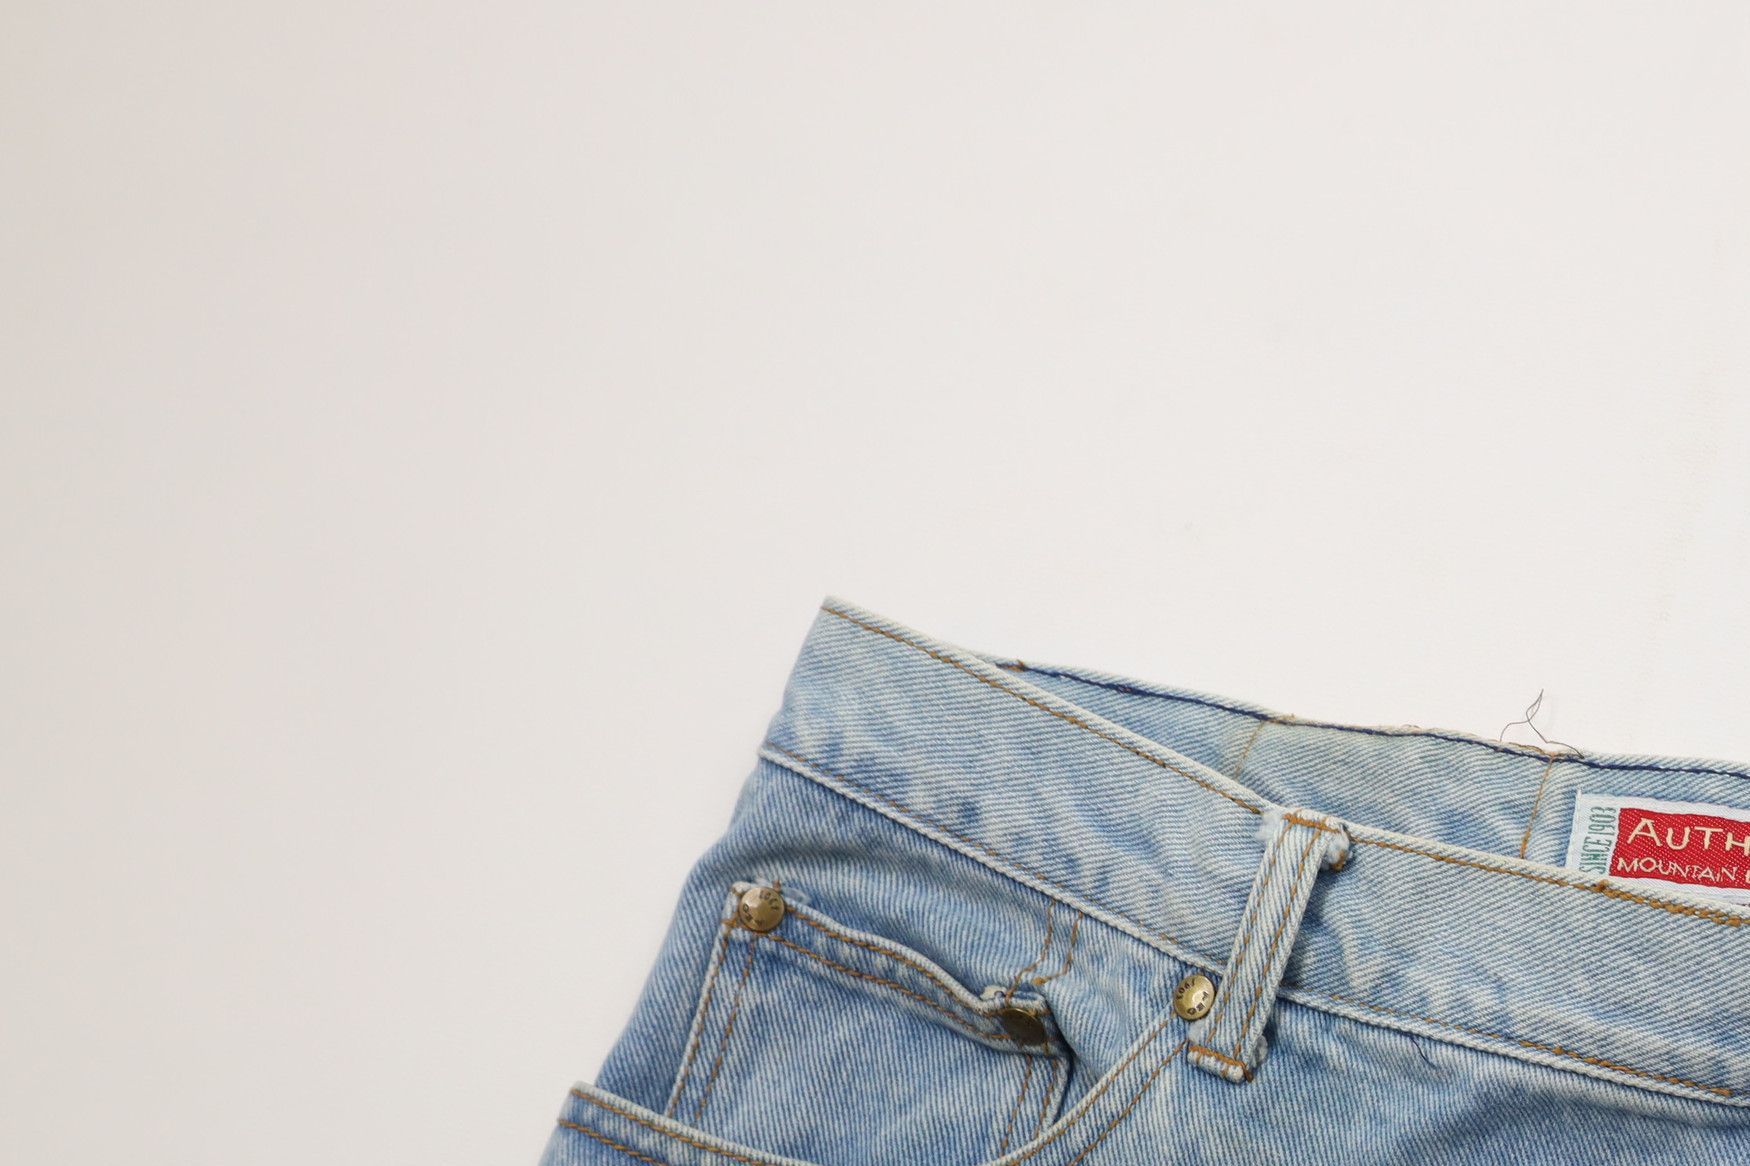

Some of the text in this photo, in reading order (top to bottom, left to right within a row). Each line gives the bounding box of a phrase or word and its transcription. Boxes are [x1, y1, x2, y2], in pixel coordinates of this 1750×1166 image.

[1579, 806, 1616, 874] SINCE 1903
[1617, 857, 1738, 882] MOUNTAIN
